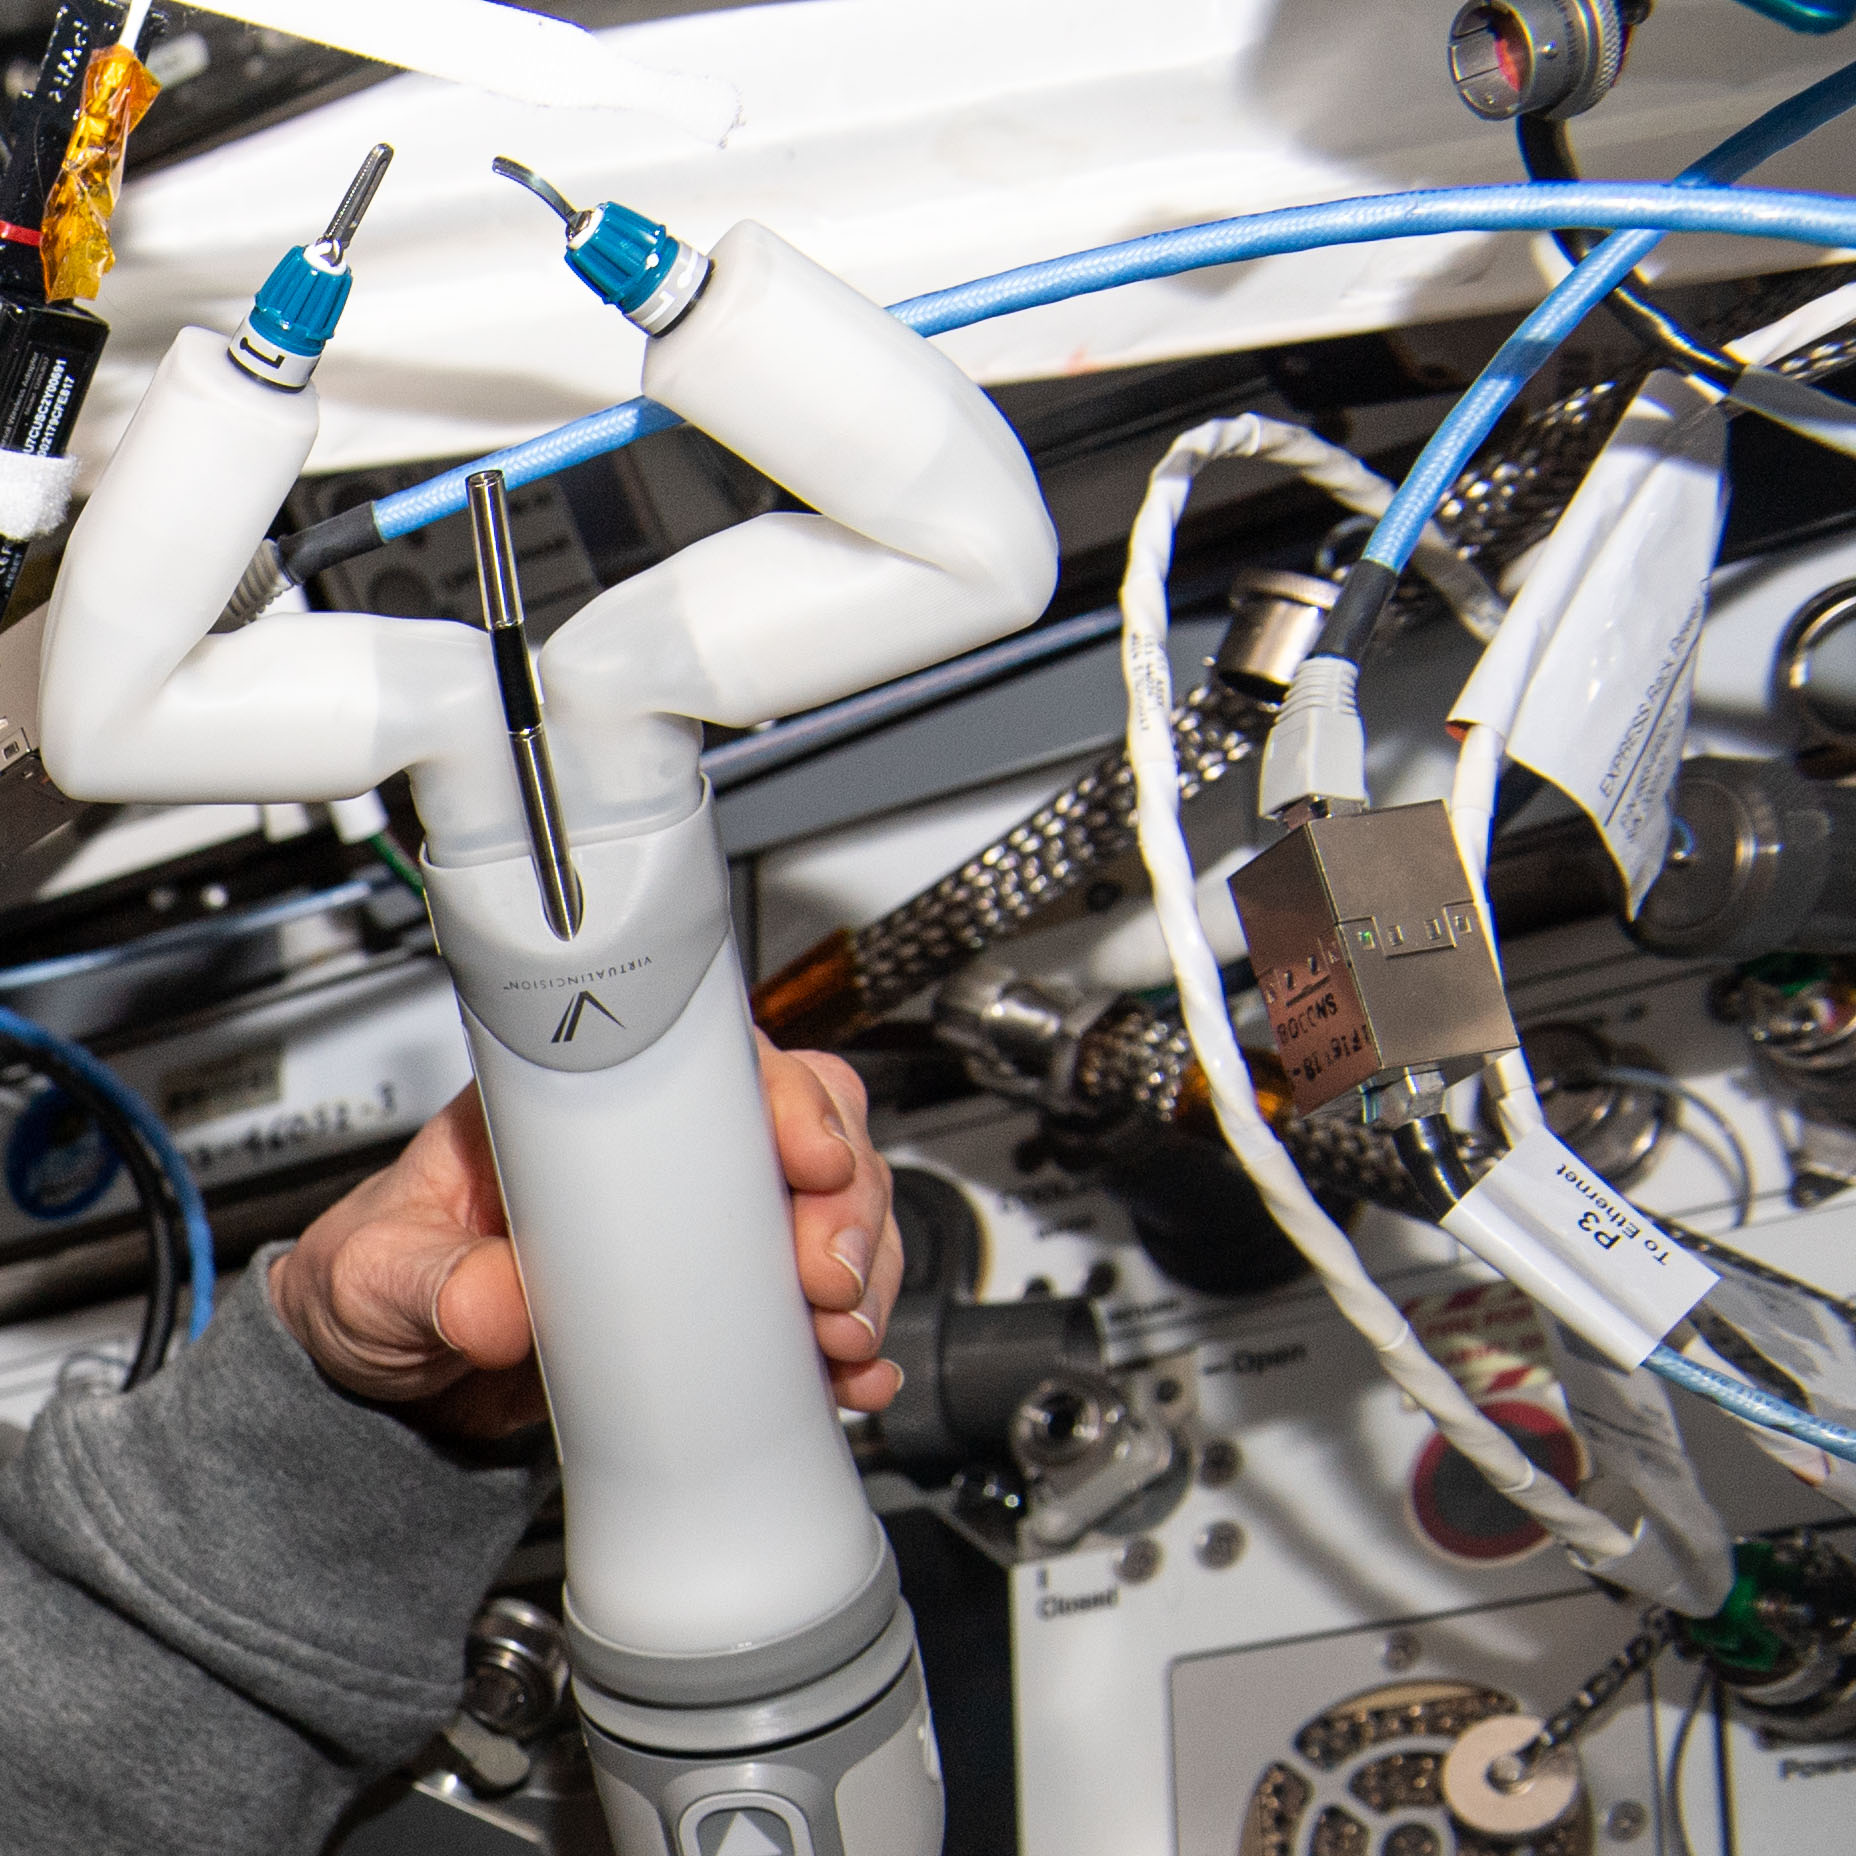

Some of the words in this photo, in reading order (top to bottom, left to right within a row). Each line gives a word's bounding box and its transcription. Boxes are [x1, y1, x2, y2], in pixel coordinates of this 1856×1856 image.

[1554, 1162, 1642, 1241] Ethernet
[1577, 1211, 1622, 1251] P3
[1644, 1238, 1673, 1267] To
[1036, 1590, 1119, 1620] Closed
